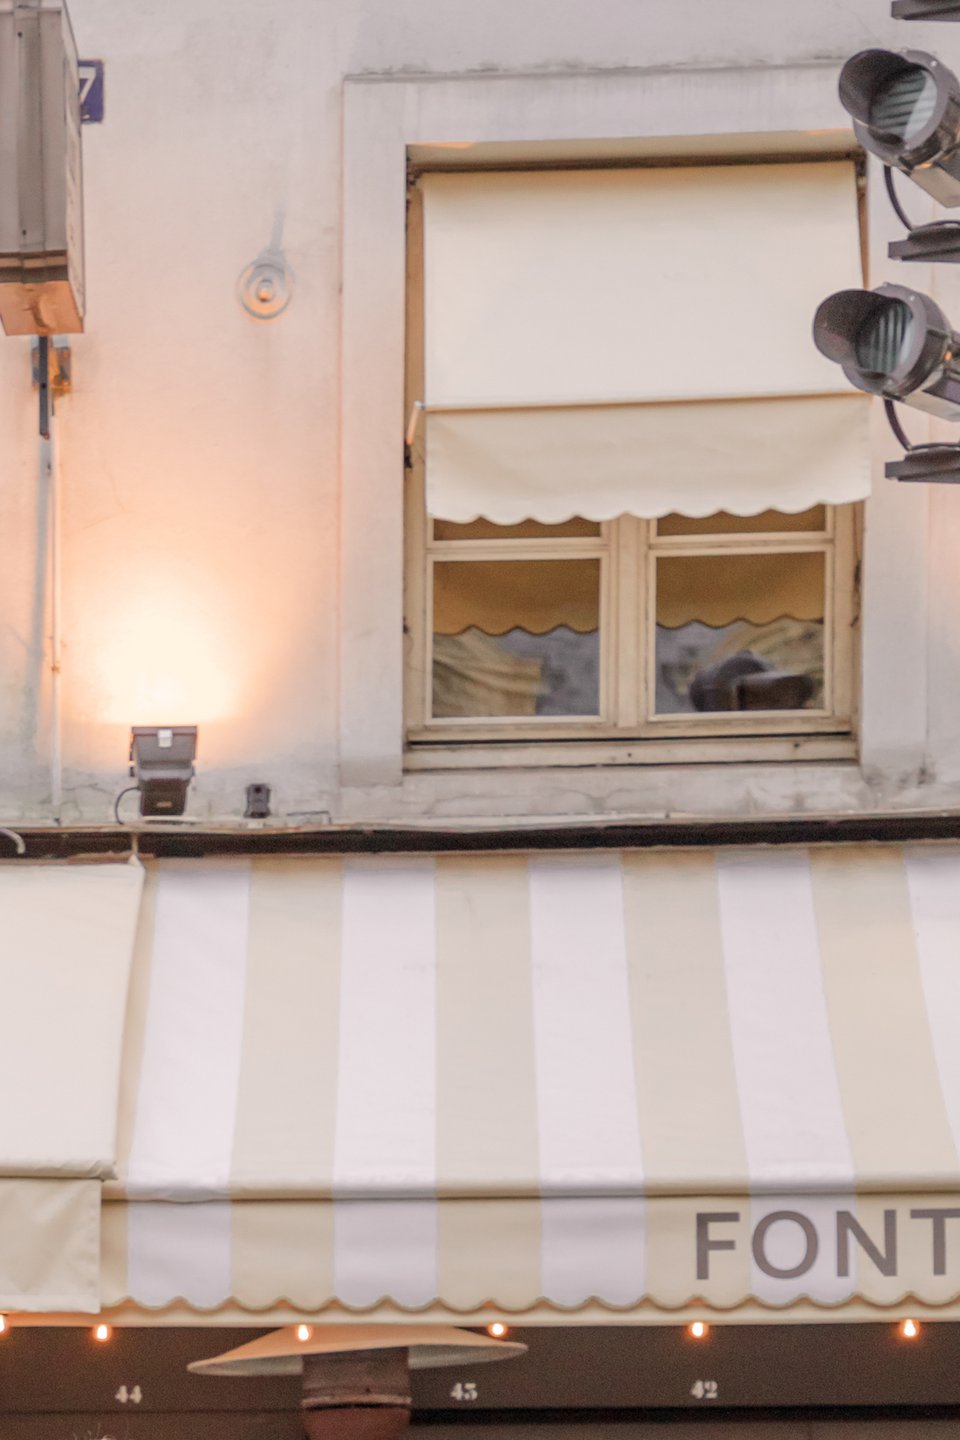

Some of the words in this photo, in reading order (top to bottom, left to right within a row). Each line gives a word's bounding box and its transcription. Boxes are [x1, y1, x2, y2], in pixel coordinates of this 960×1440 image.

[695, 1207, 960, 1280] FONT
[115, 1385, 143, 1404] 44
[690, 1380, 718, 1399] 42
